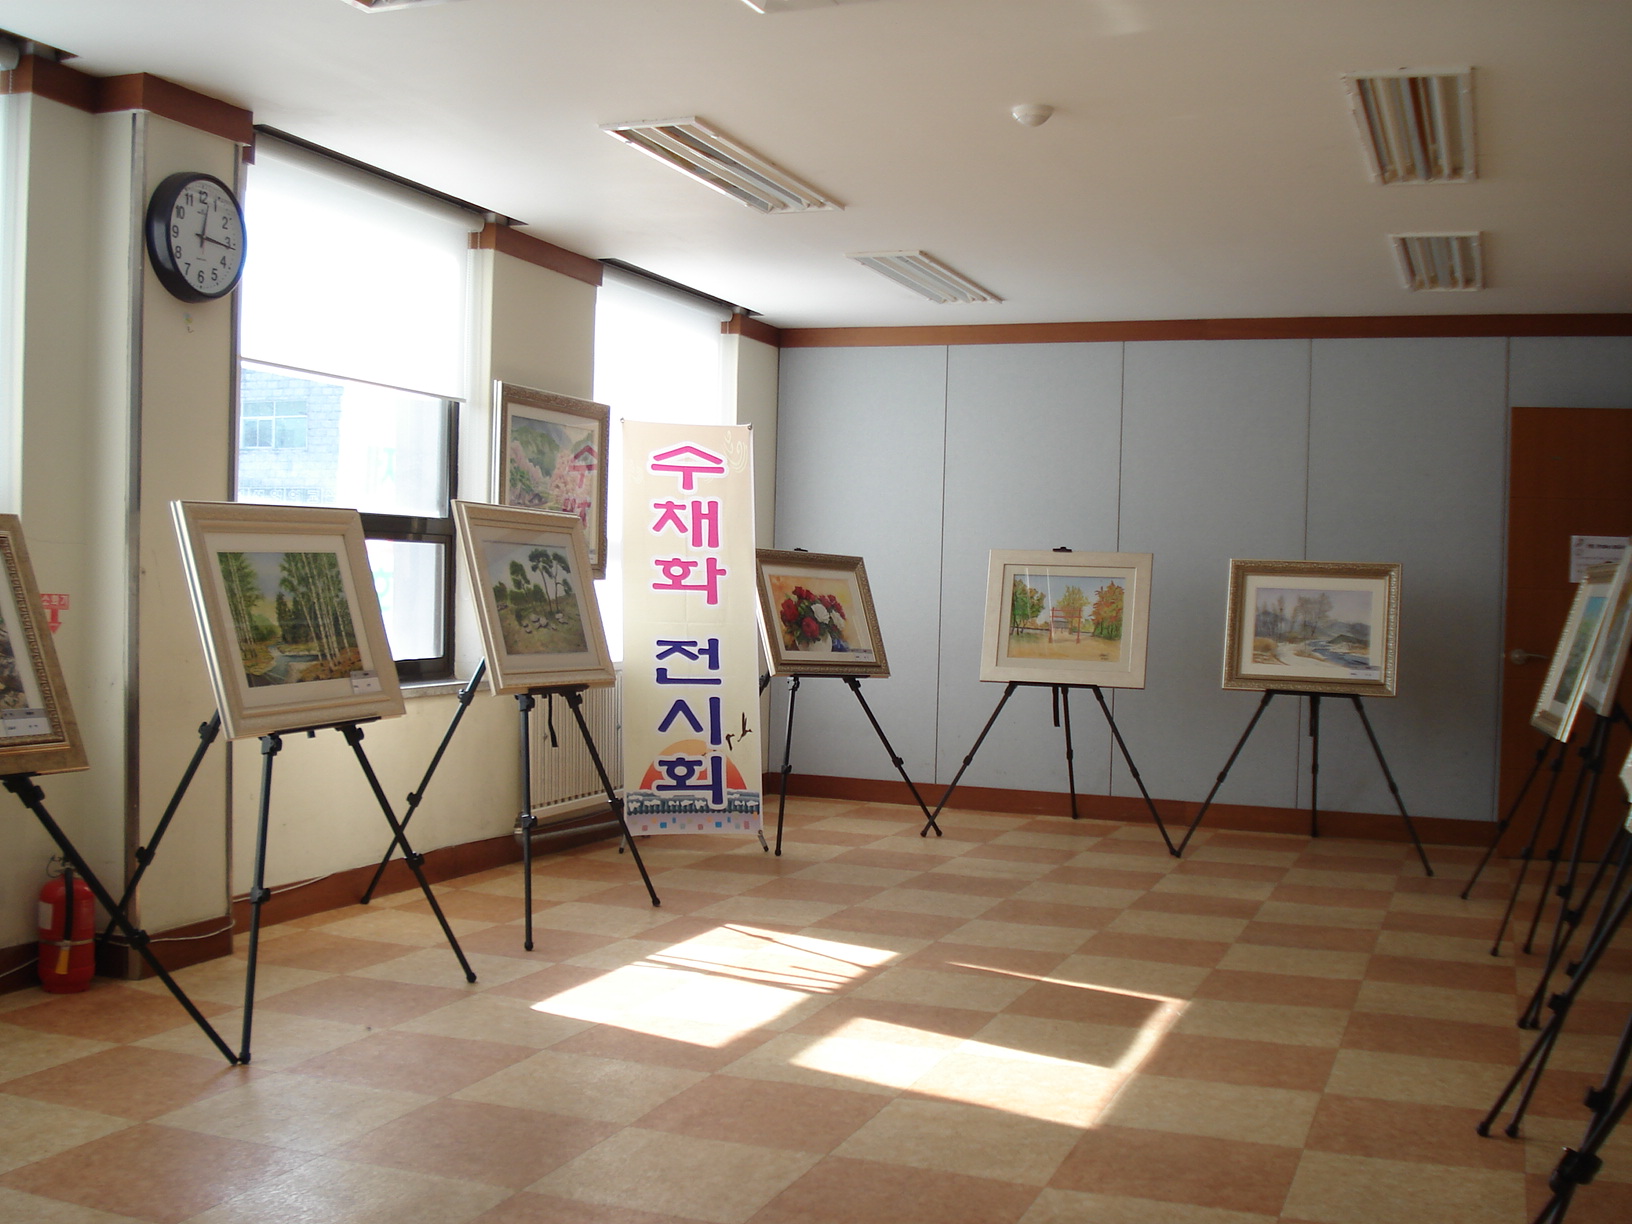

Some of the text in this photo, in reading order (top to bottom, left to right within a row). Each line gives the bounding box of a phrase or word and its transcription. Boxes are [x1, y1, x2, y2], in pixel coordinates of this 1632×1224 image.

[185, 193, 194, 206] 11
[199, 190, 208, 205] 12
[175, 205, 185, 219] 10
[213, 199, 217, 212] 1
[222, 216, 229, 230] 2
[172, 225, 179, 238] 9
[224, 237, 231, 249] 3
[174, 246, 182, 259] 8
[184, 262, 191, 275] 7
[220, 256, 227, 268] 4
[198, 270, 204, 283] 6
[211, 268, 218, 281] 5
[651, 445, 727, 805] 수채화 전시회
